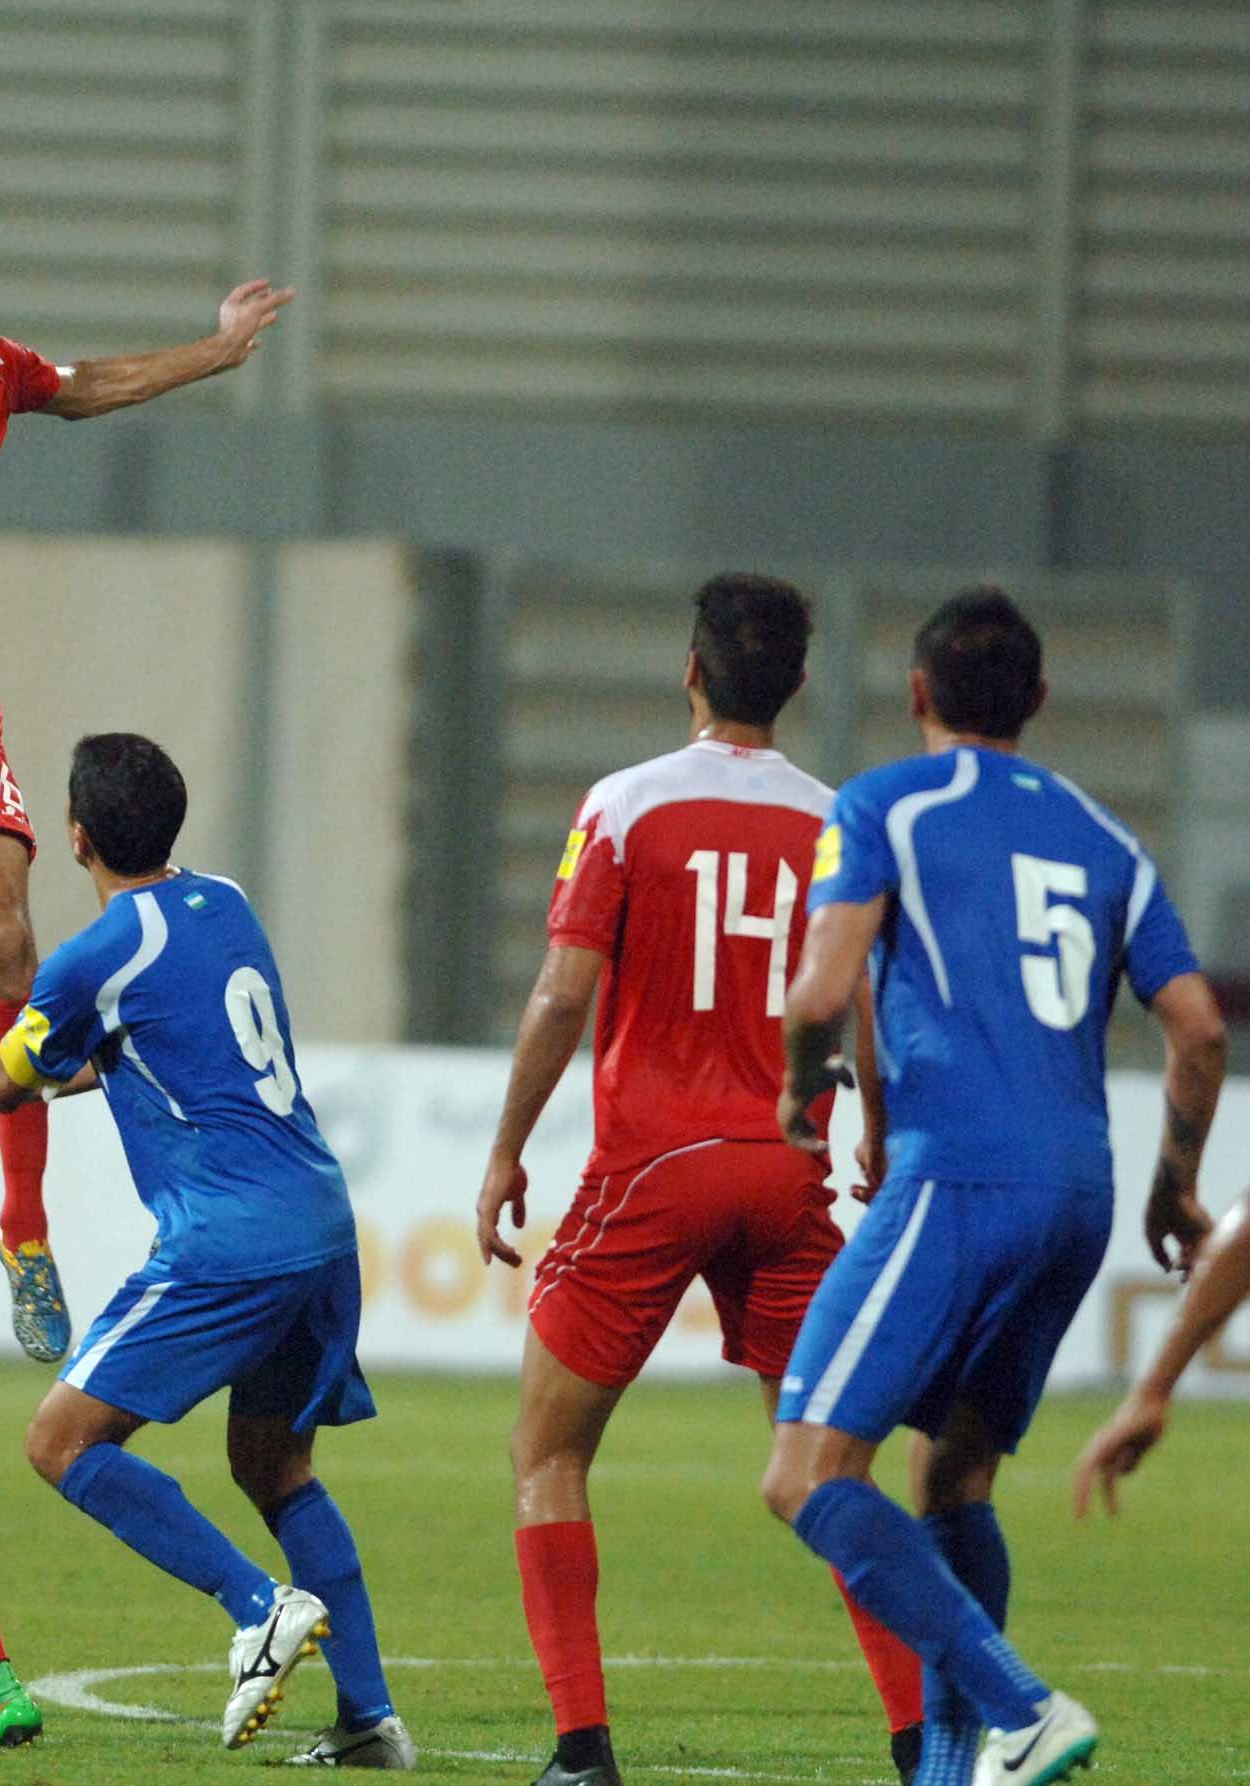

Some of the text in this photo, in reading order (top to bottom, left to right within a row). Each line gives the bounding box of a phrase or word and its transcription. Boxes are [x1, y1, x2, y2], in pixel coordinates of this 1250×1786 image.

[685, 850, 799, 1018] 14
[1011, 852, 1096, 1031] 5
[225, 966, 297, 1117] 9
